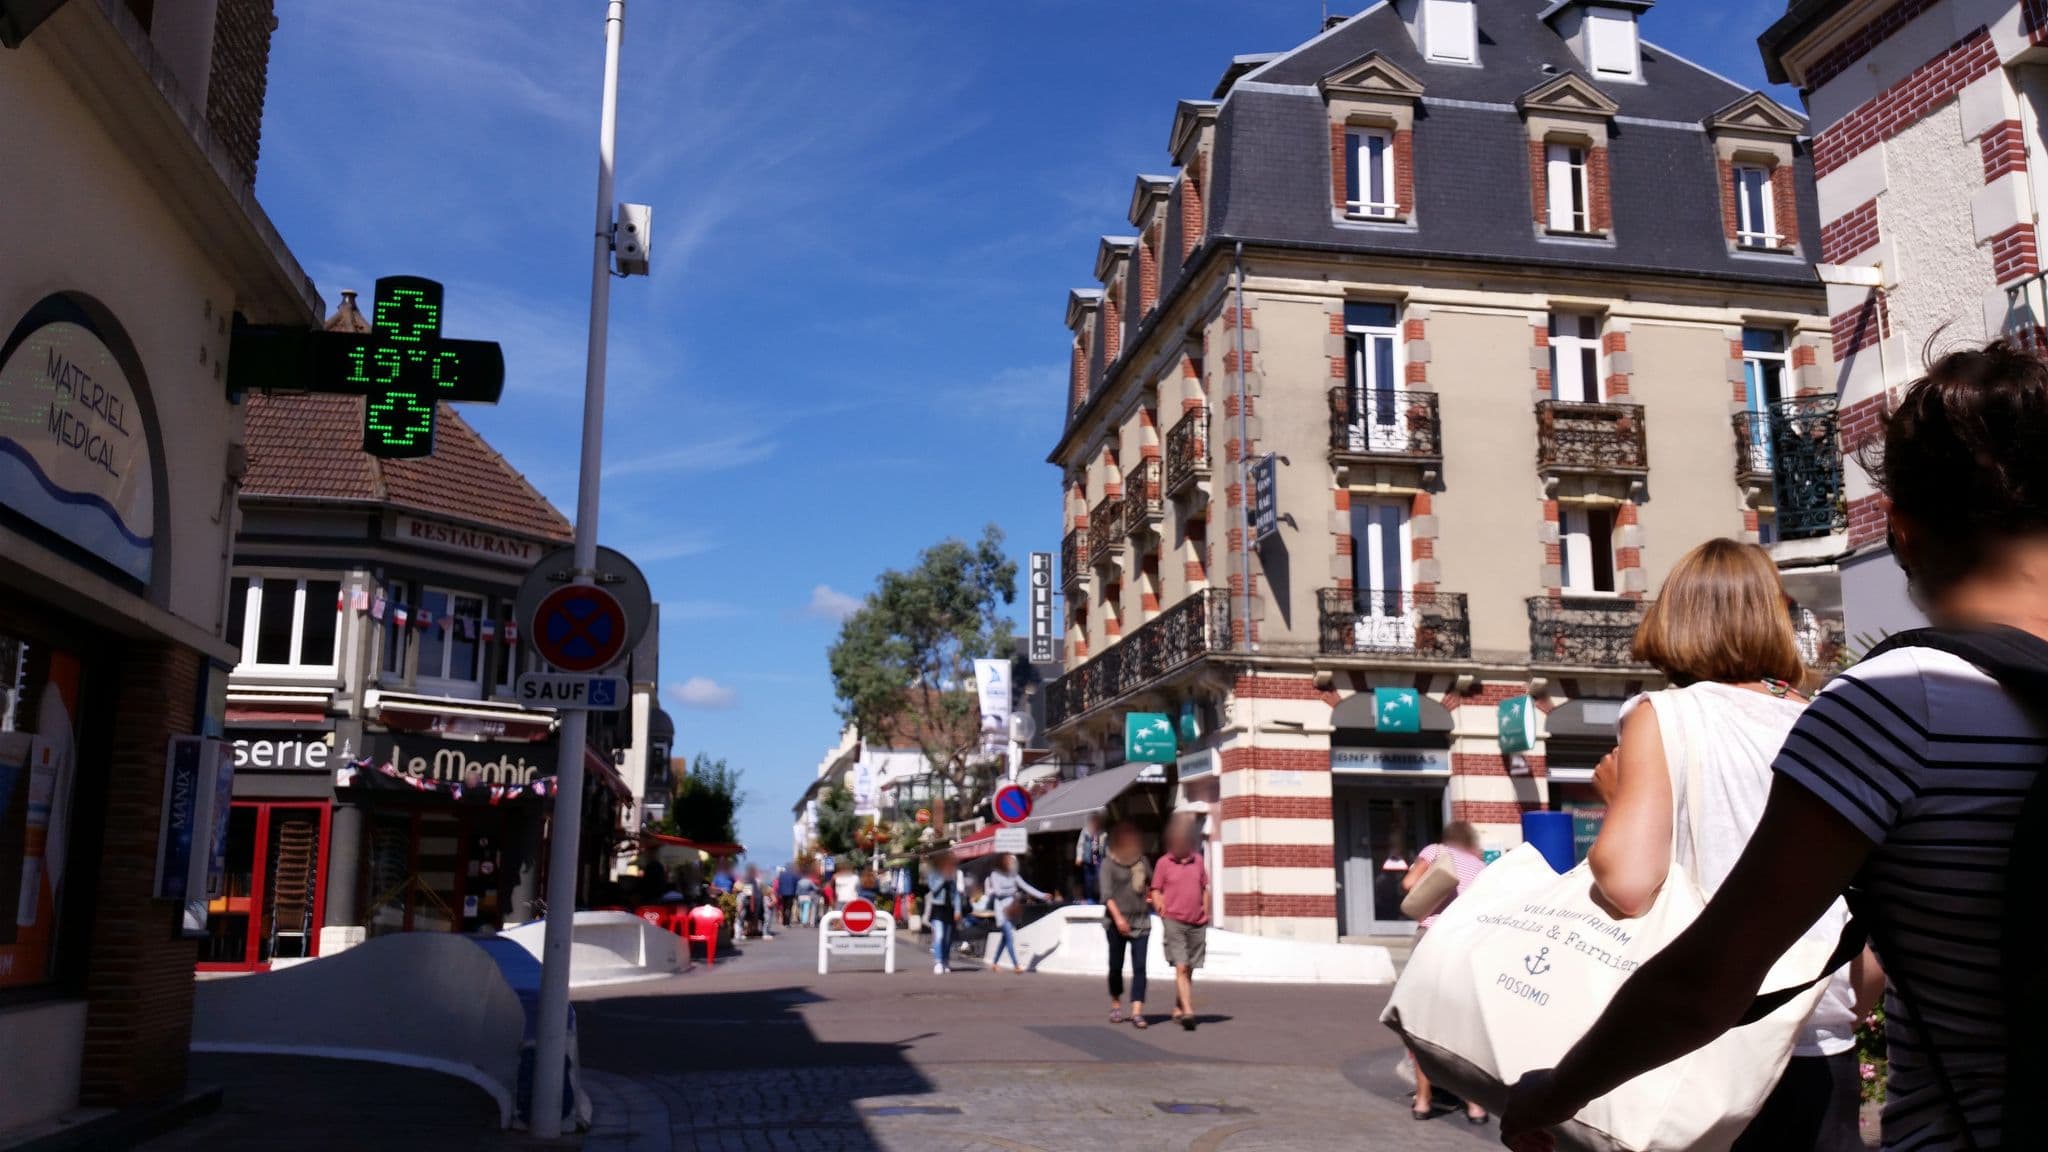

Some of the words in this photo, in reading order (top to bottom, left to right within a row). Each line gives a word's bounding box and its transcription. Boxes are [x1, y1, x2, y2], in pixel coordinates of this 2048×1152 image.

[46, 346, 129, 437] MATERIEL
[47, 403, 120, 478] MEDICAL
[410, 520, 532, 559] RESTAURANT
[1033, 555, 1050, 637] HOTEL
[523, 681, 586, 701] SAUF
[233, 738, 327, 768] serie
[391, 745, 427, 778] Le
[433, 748, 537, 786] Menhir
[172, 771, 191, 827] MANIX
[1546, 924, 1561, 941] &
[1496, 973, 1550, 1006] POSOMO
